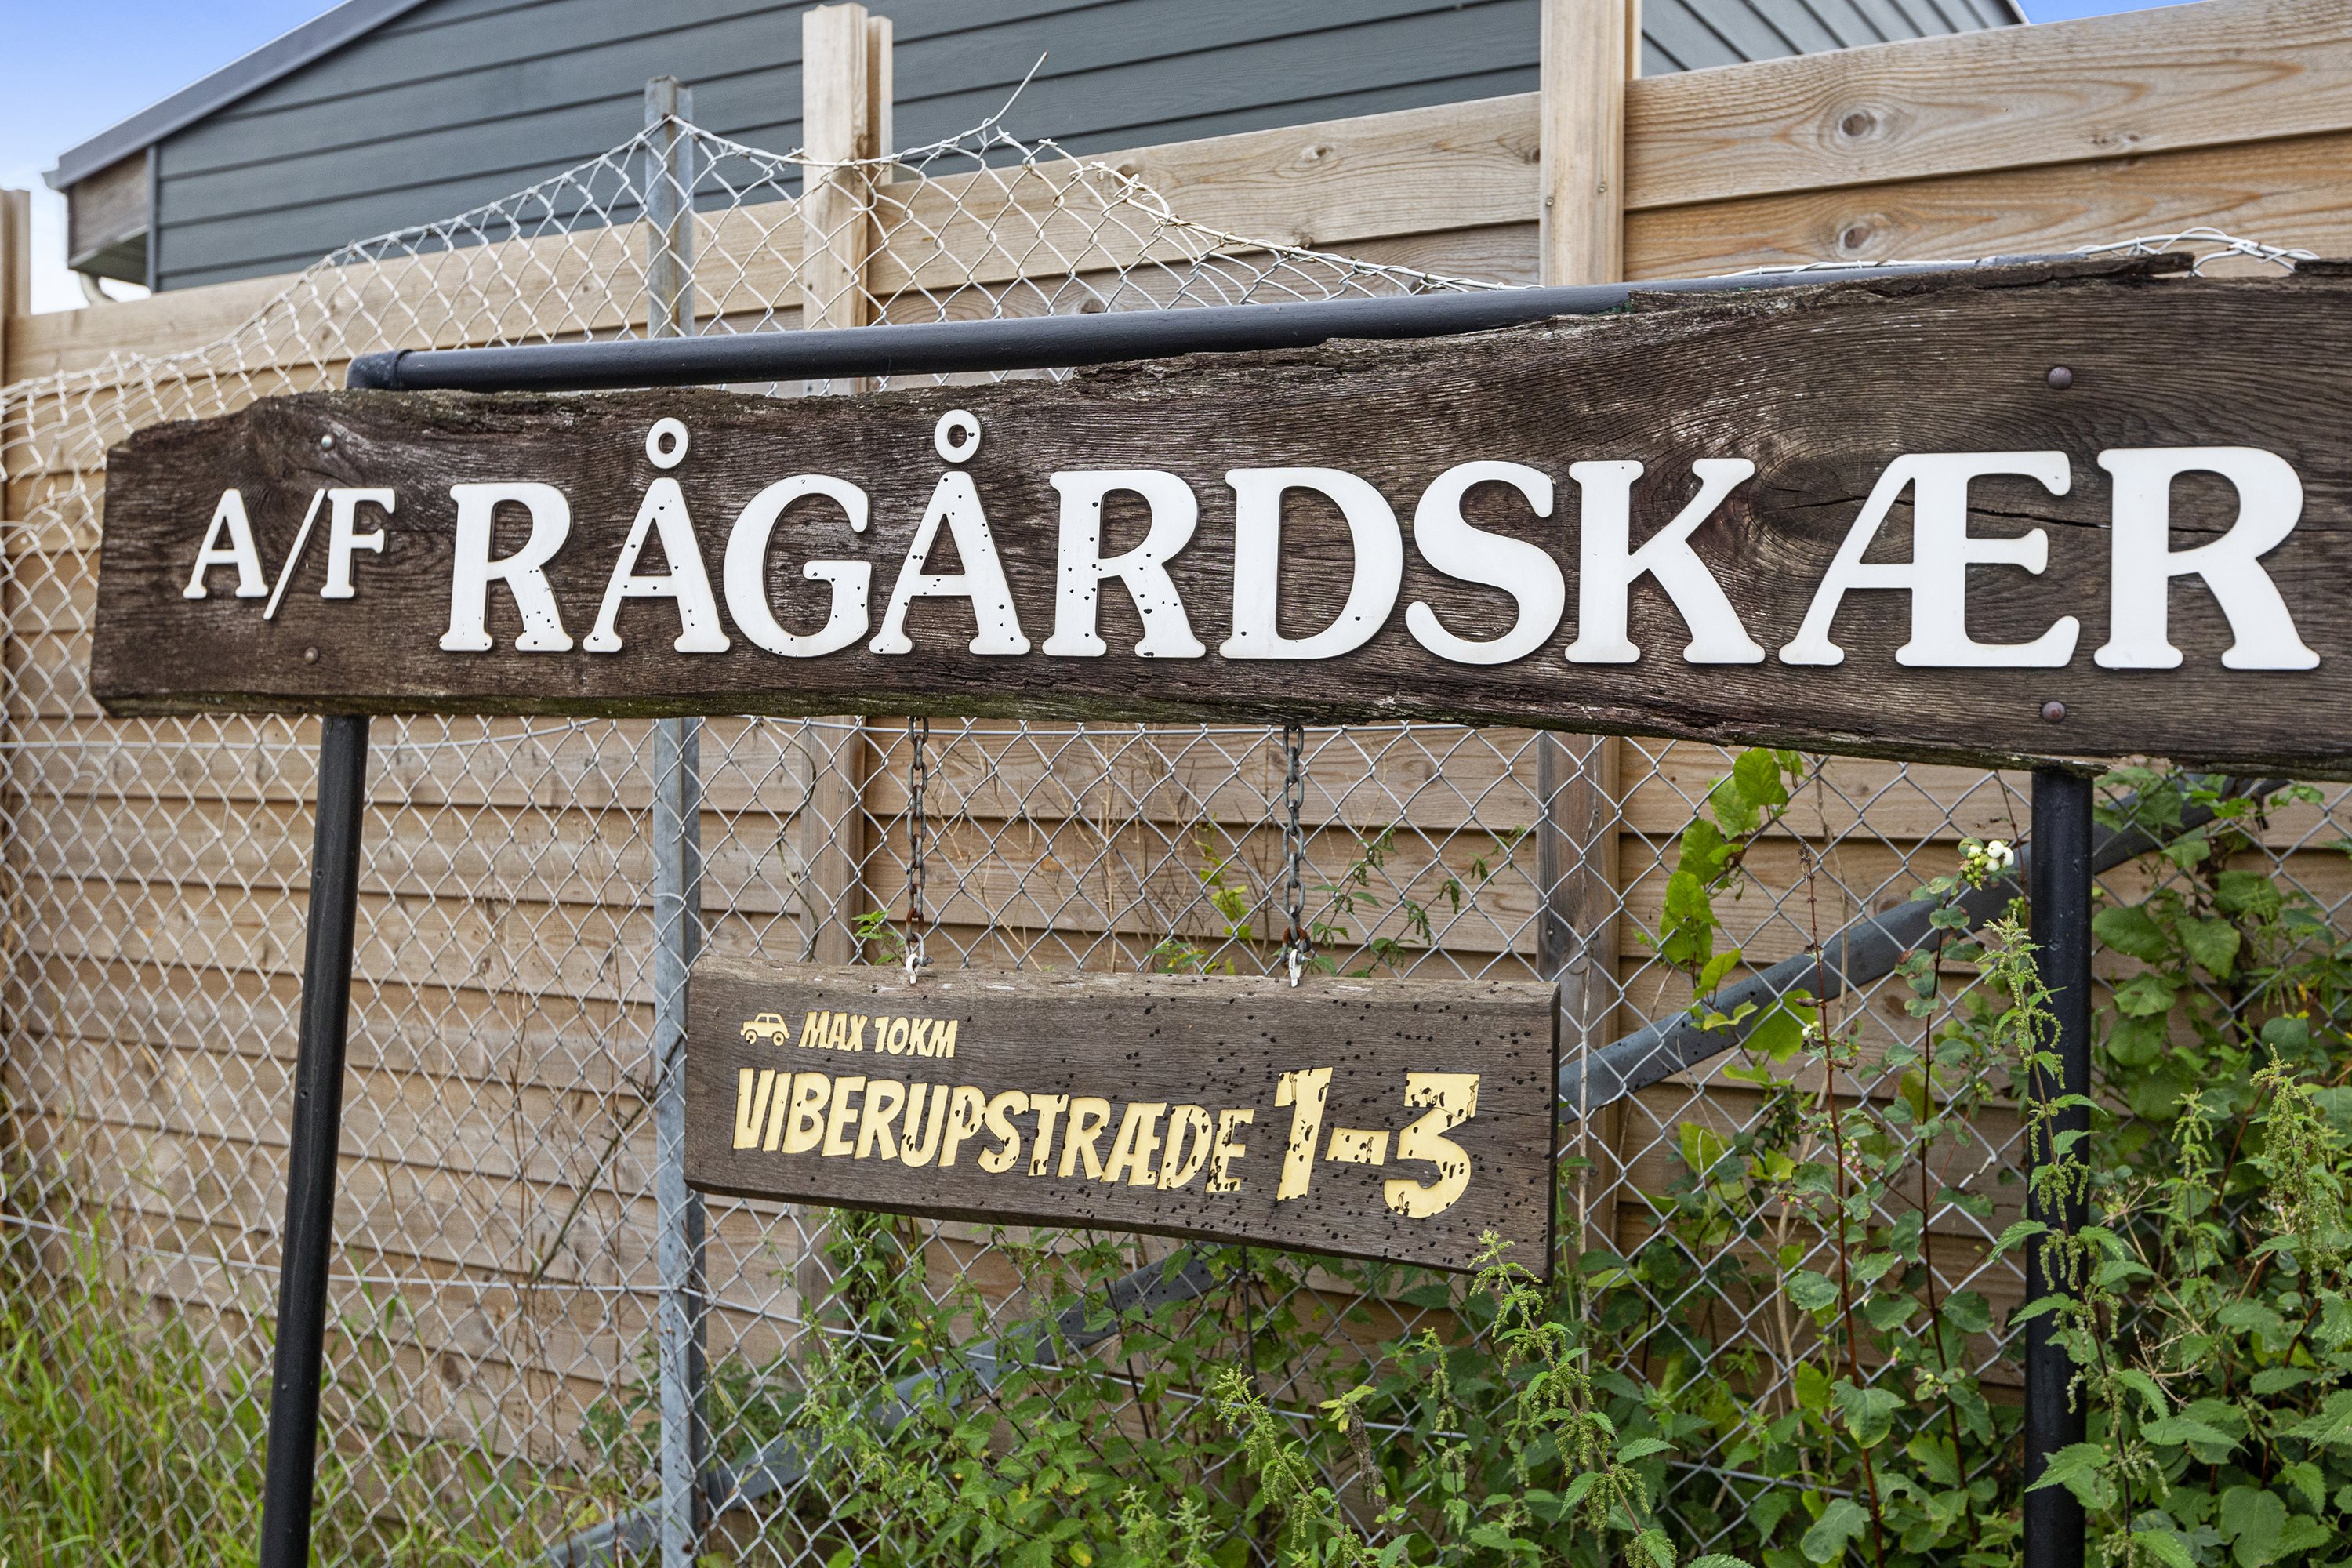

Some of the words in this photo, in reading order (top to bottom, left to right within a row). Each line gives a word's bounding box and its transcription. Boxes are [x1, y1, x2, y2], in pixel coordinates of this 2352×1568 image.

[182, 487, 396, 619] A/F
[438, 409, 2321, 670] RÅGÅRDSKÆR
[798, 1010, 869, 1052] MAX
[874, 1017, 959, 1058] 10KM
[732, 1067, 1256, 1194] VIBERUPSTRÆDE
[1273, 1066, 1480, 1219] 1-3
